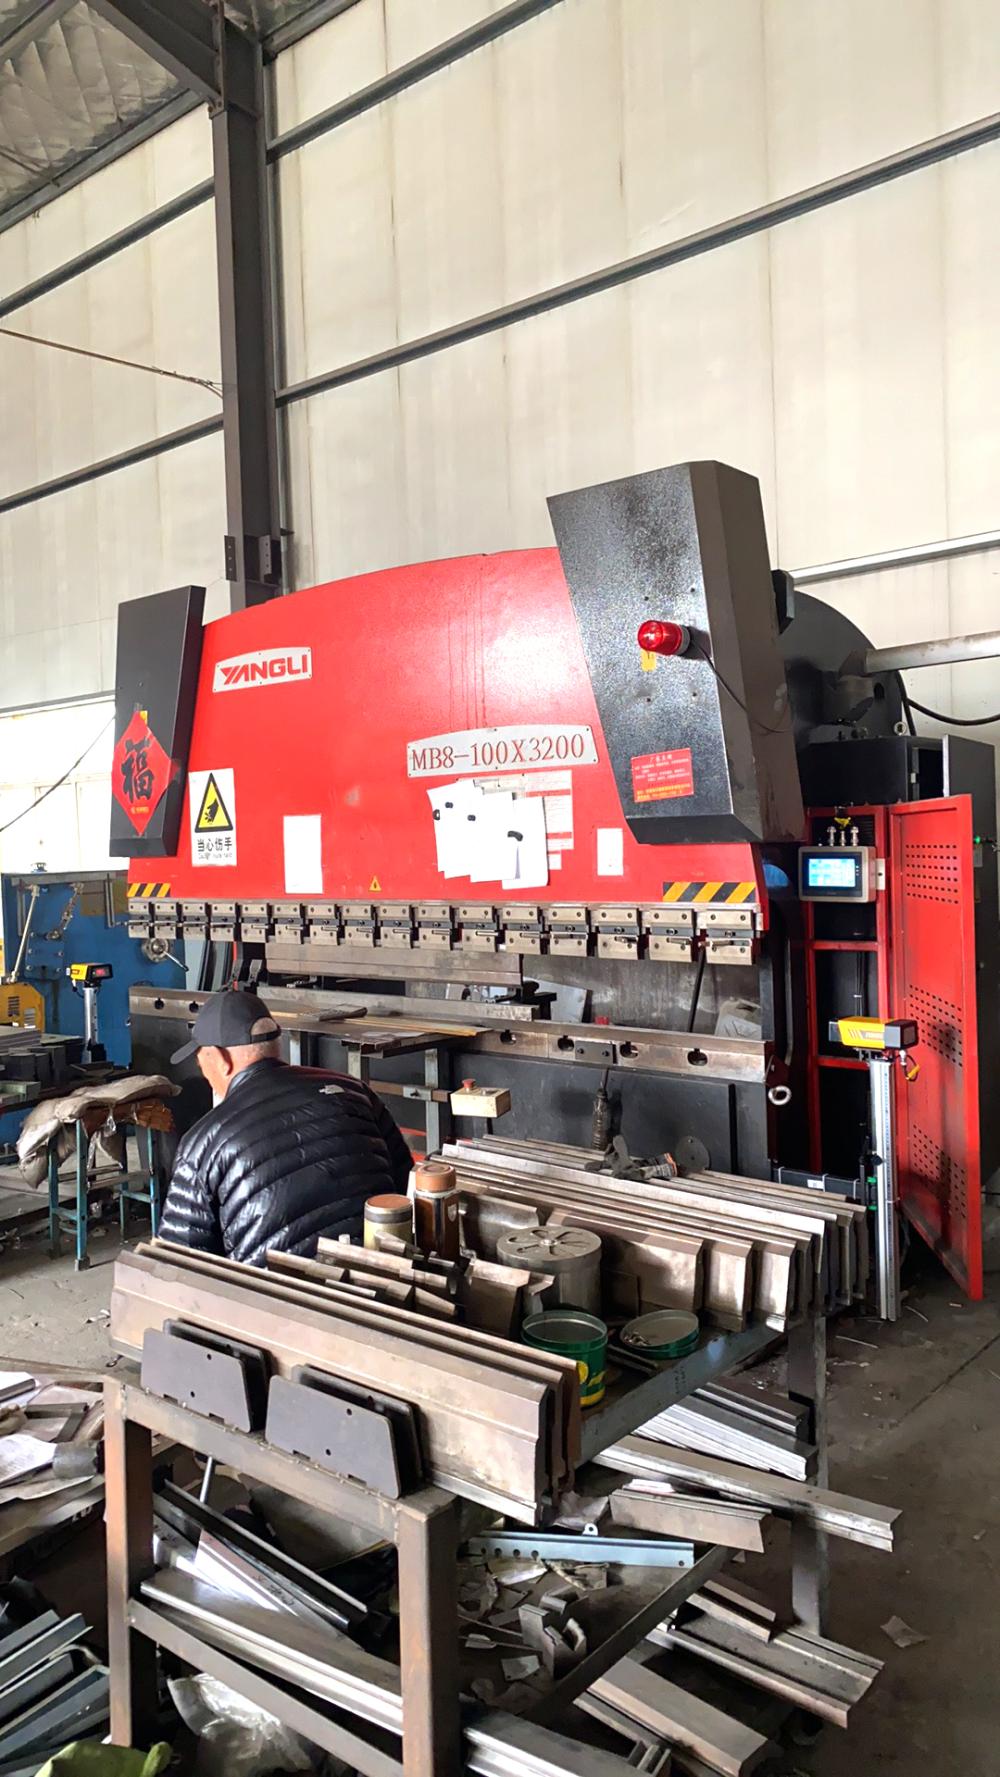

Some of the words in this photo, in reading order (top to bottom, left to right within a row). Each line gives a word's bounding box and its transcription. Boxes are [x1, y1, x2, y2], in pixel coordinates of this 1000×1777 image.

[220, 654, 308, 685] YANGLI
[121, 737, 154, 803] 福
[411, 734, 585, 771] MB8-100X3200
